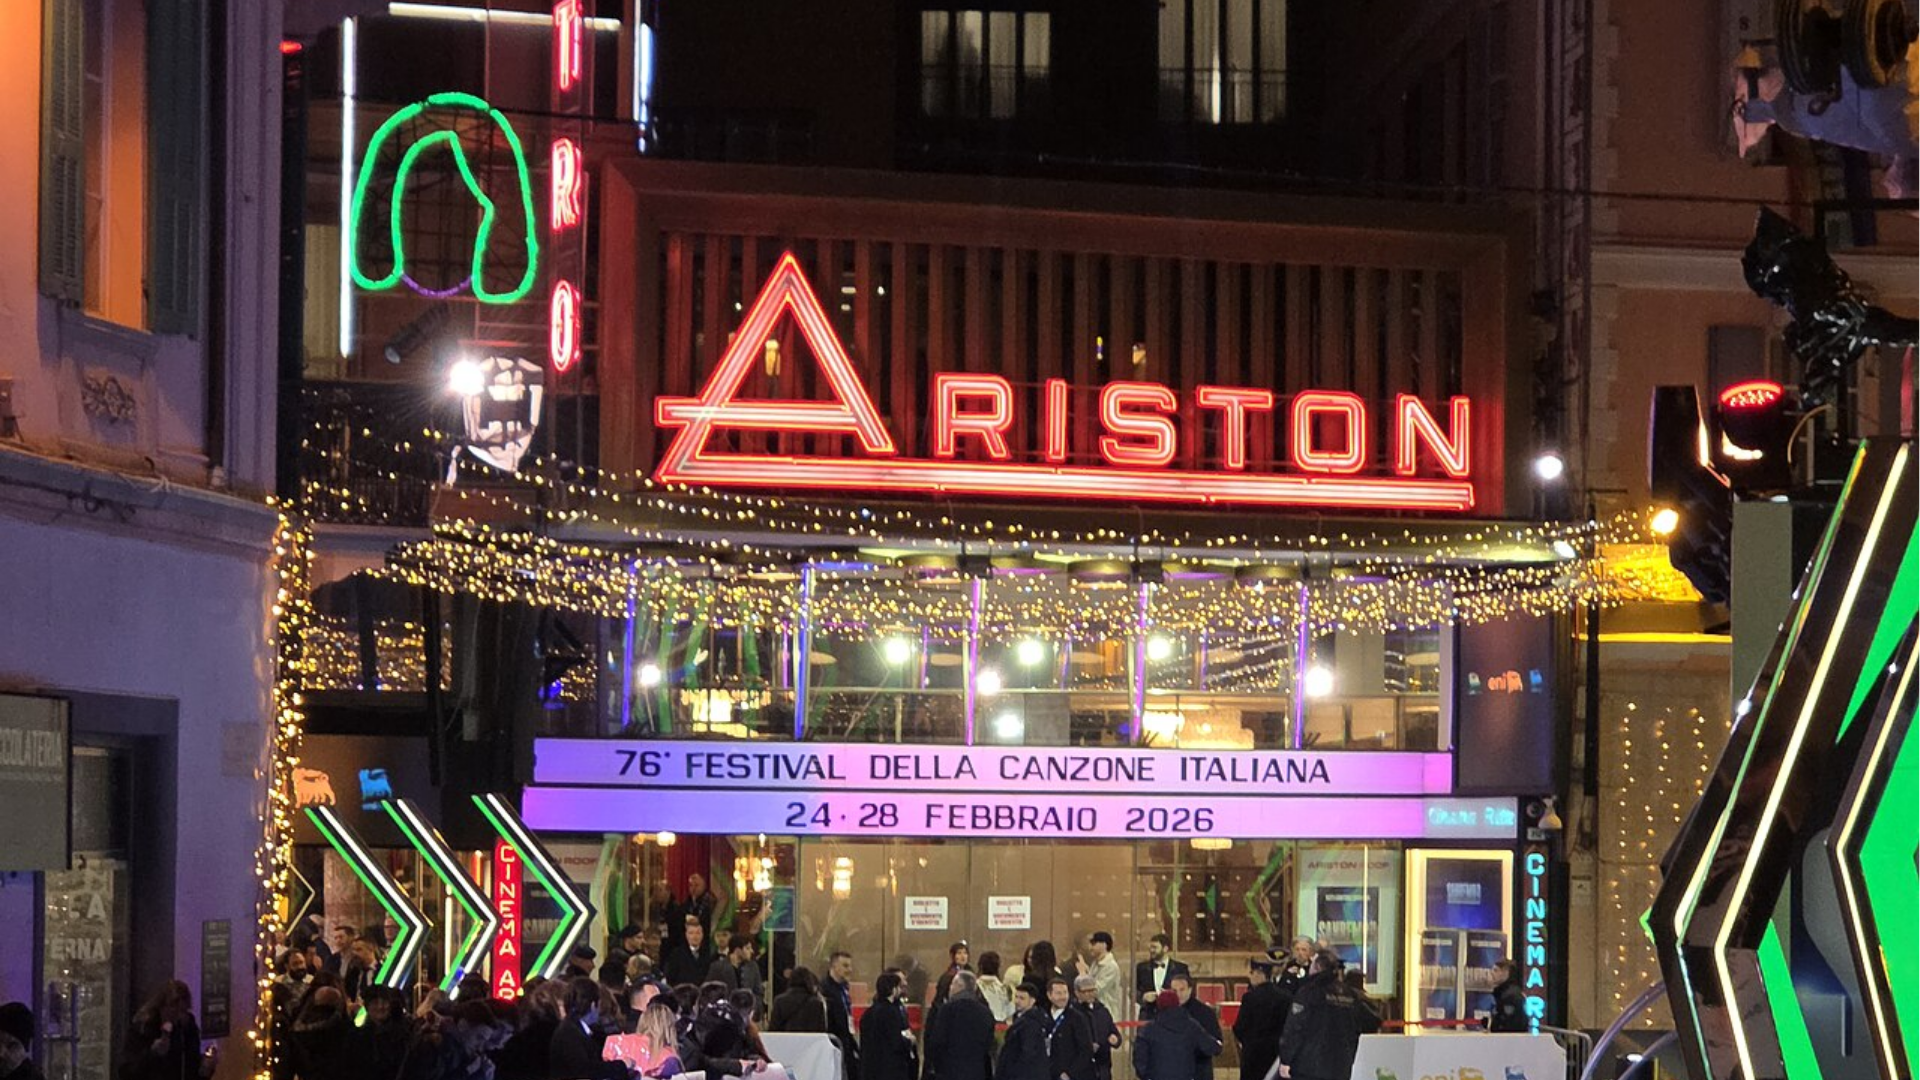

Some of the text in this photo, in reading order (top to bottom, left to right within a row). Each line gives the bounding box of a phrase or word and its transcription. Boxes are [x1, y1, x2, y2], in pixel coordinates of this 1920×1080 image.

[655, 250, 1475, 511] ARISTON
[685, 753, 846, 780] FESTIVAL
[870, 755, 977, 780] DELLA
[999, 755, 1155, 782] CANZONE
[1180, 756, 1331, 783] ITALIANA
[925, 804, 1097, 832] FEBBRAIO
[1125, 807, 1214, 832] 2026
[498, 844, 517, 957] CINEMA
[1525, 853, 1546, 988] CINEMA
